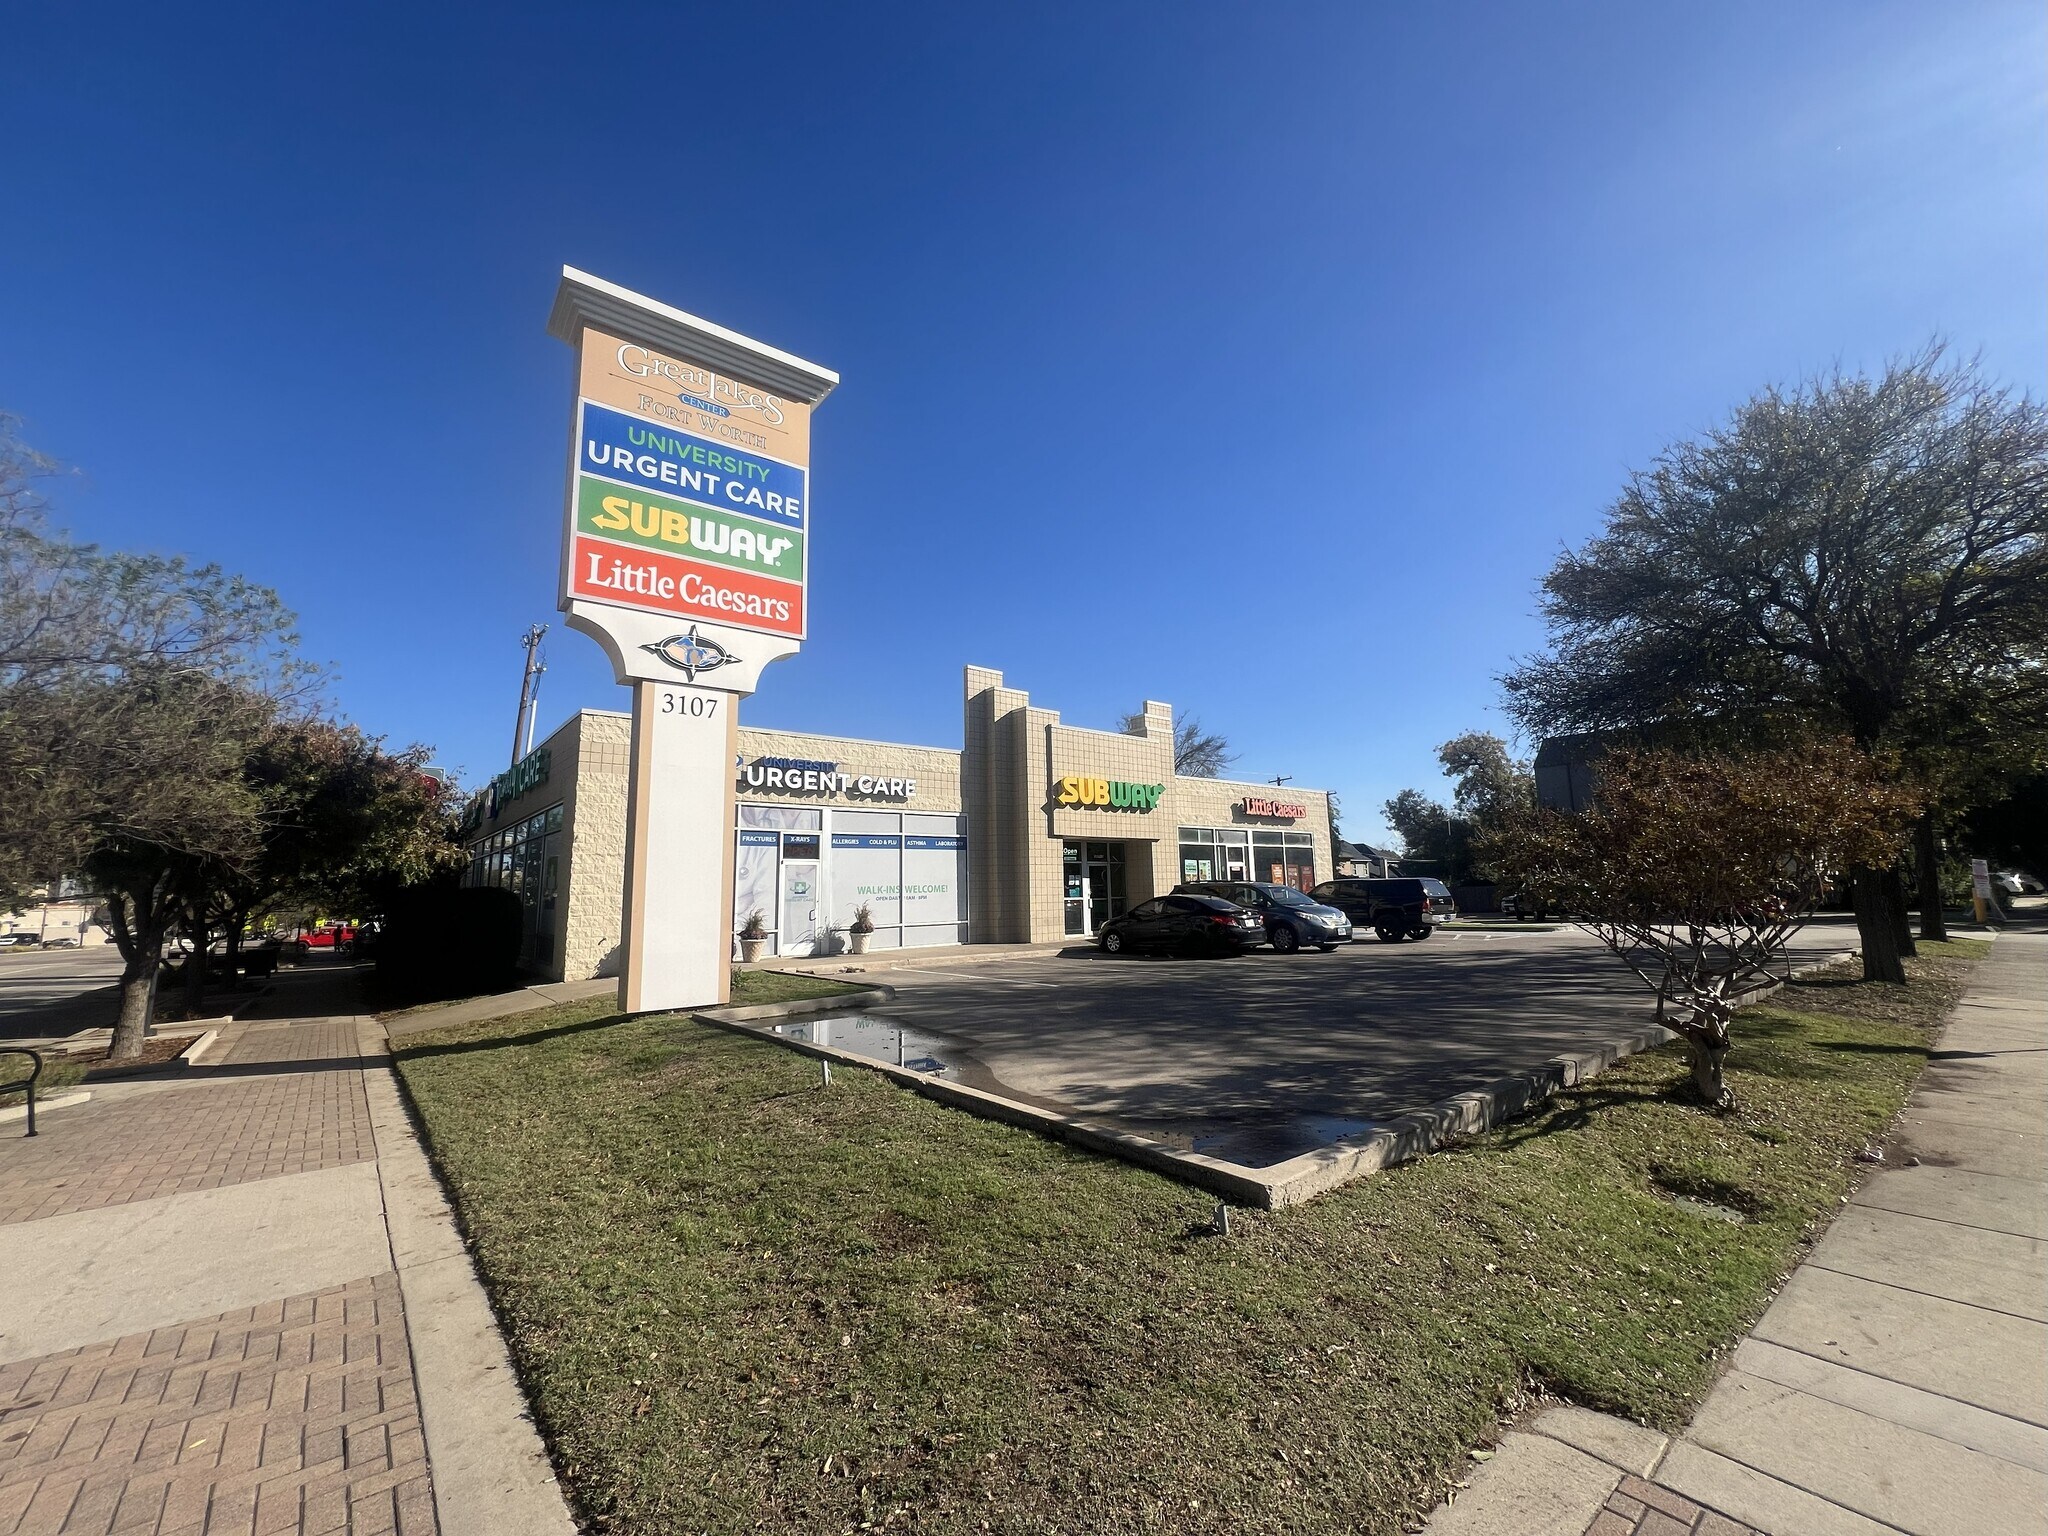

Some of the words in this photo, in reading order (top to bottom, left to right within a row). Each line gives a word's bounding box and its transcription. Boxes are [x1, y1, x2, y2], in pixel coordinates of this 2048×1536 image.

[638, 393, 693, 425] FORT
[697, 412, 767, 450] WORTH
[681, 394, 727, 417] CENTER
[627, 425, 771, 483] UNIVERSITY
[587, 439, 721, 495] URGENT
[725, 480, 800, 519] CARE
[590, 495, 794, 567] SUBWAY
[585, 552, 675, 599] Little
[679, 573, 791, 622] Caesars
[661, 692, 718, 719] 3107
[763, 756, 840, 772] UNIVERSITY
[746, 765, 851, 792] URGENT
[857, 775, 917, 797] CARE
[1058, 776, 1166, 809] SUBWAY
[1245, 797, 1273, 818] Little
[1273, 801, 1307, 819] Caesars
[857, 885, 901, 895] WALK-INS
[904, 884, 948, 894] WELCOME!
